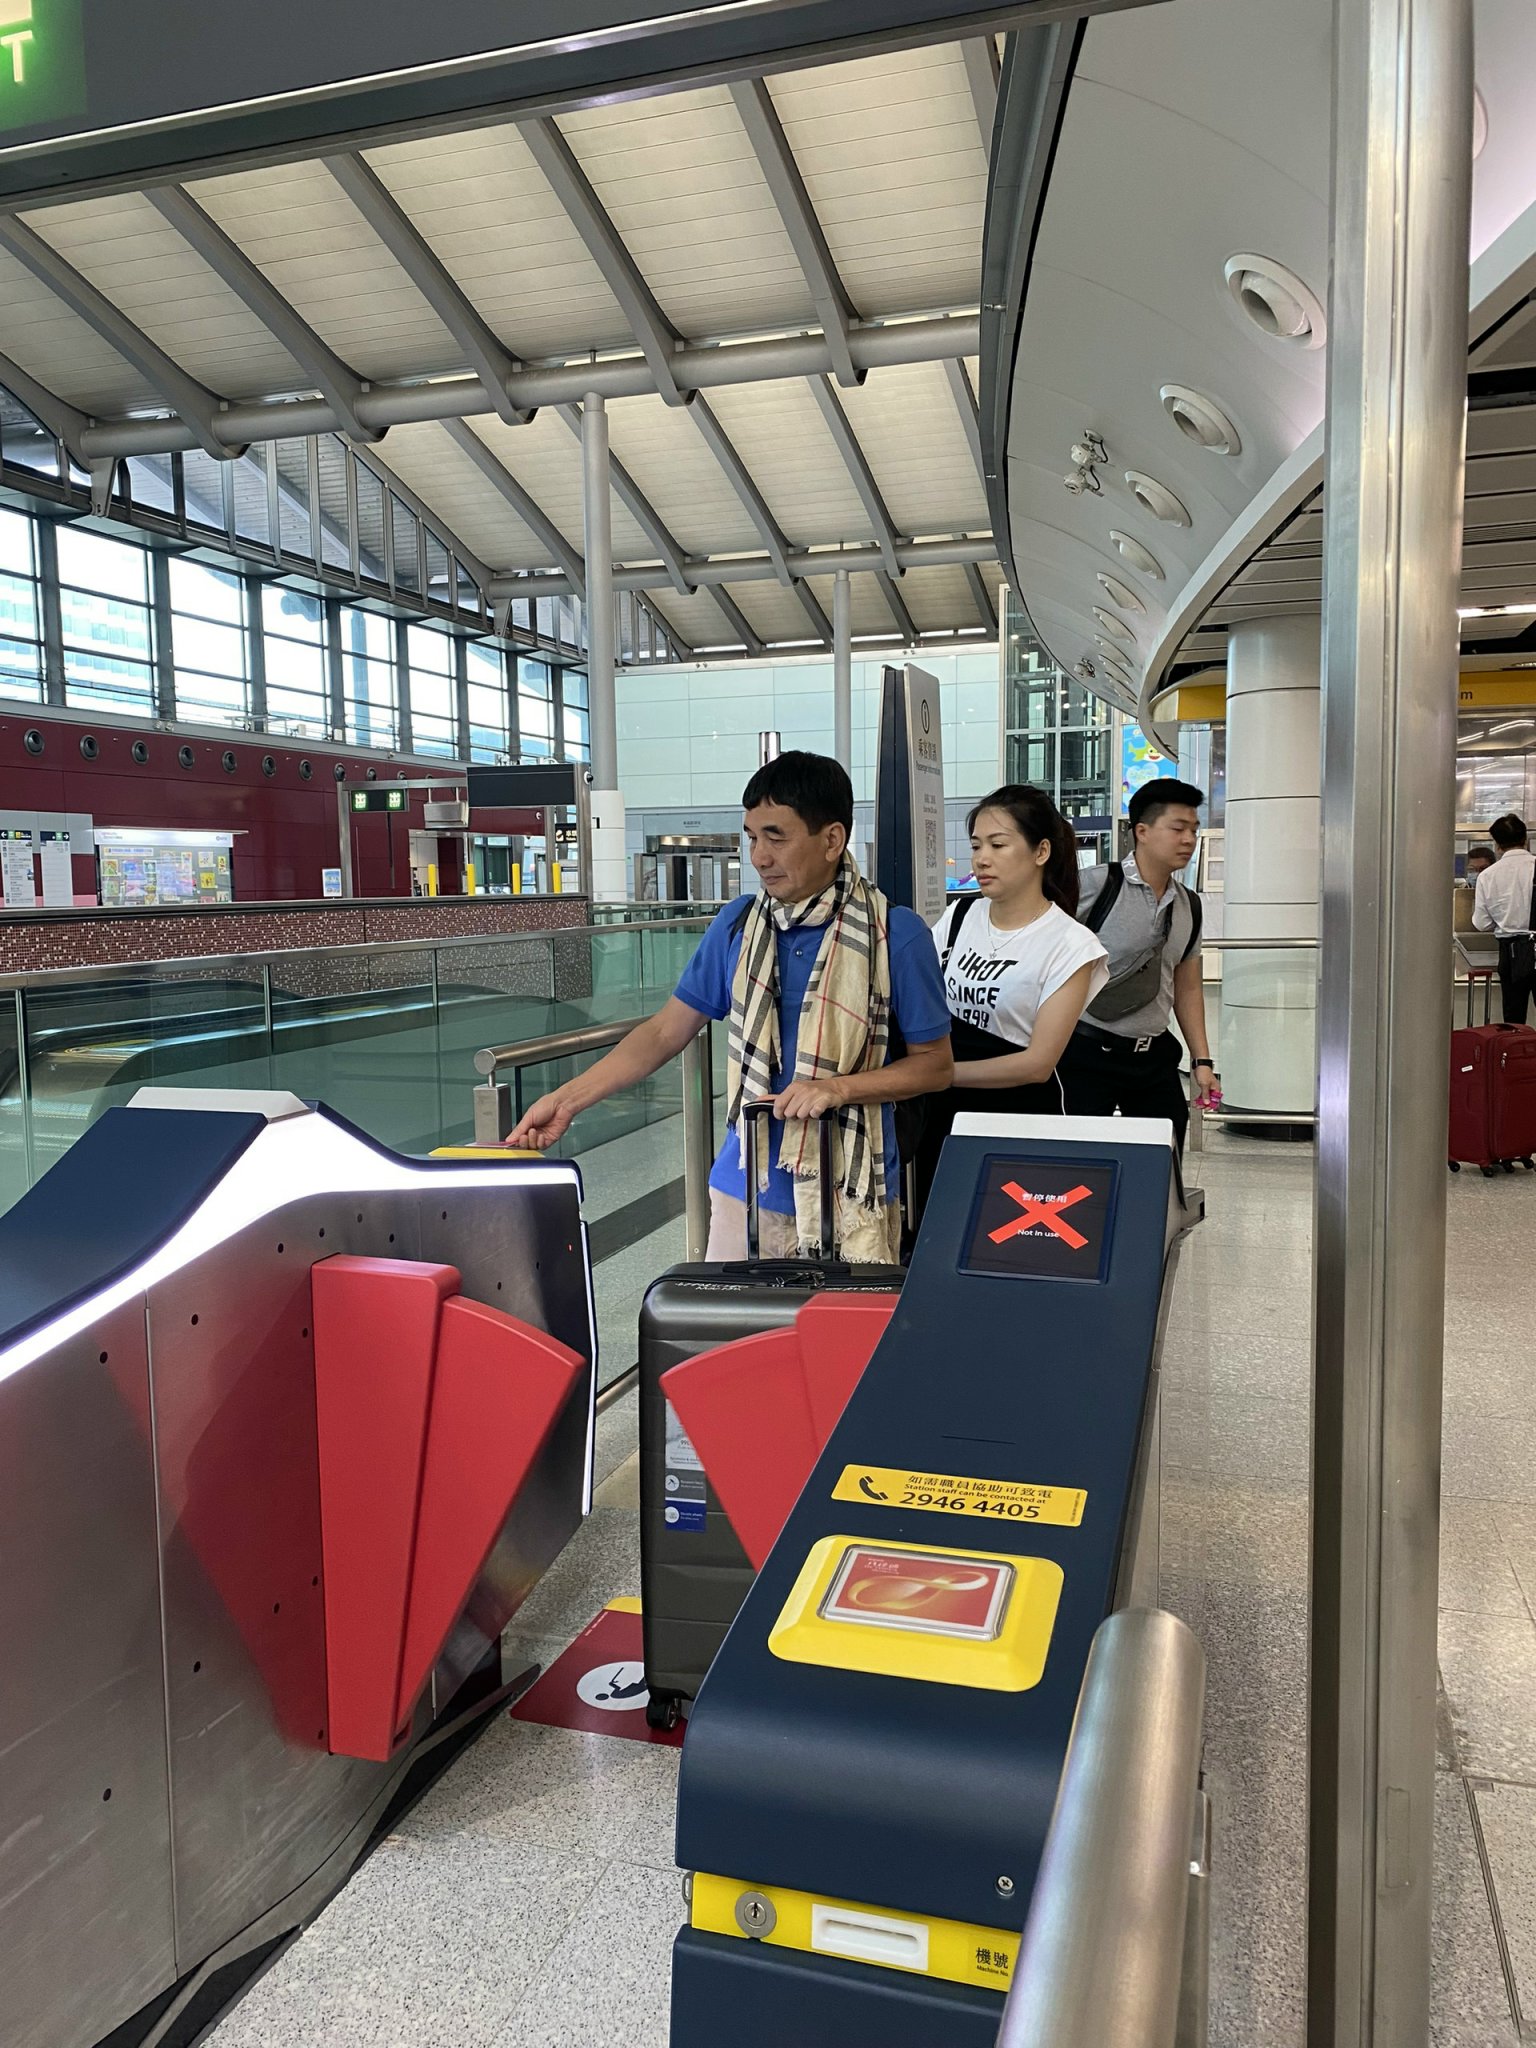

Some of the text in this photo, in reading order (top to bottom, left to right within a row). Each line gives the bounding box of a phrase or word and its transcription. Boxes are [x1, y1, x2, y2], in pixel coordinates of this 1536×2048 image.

[947, 976, 1001, 1010] SINCE
[904, 1483, 936, 1492] Station
[989, 1493, 1037, 1503] contacted
[908, 1475, 1053, 1499] 如需職員協助可致電
[899, 1491, 1041, 1518] 2946 4405
[976, 1946, 1009, 1969] 機號
